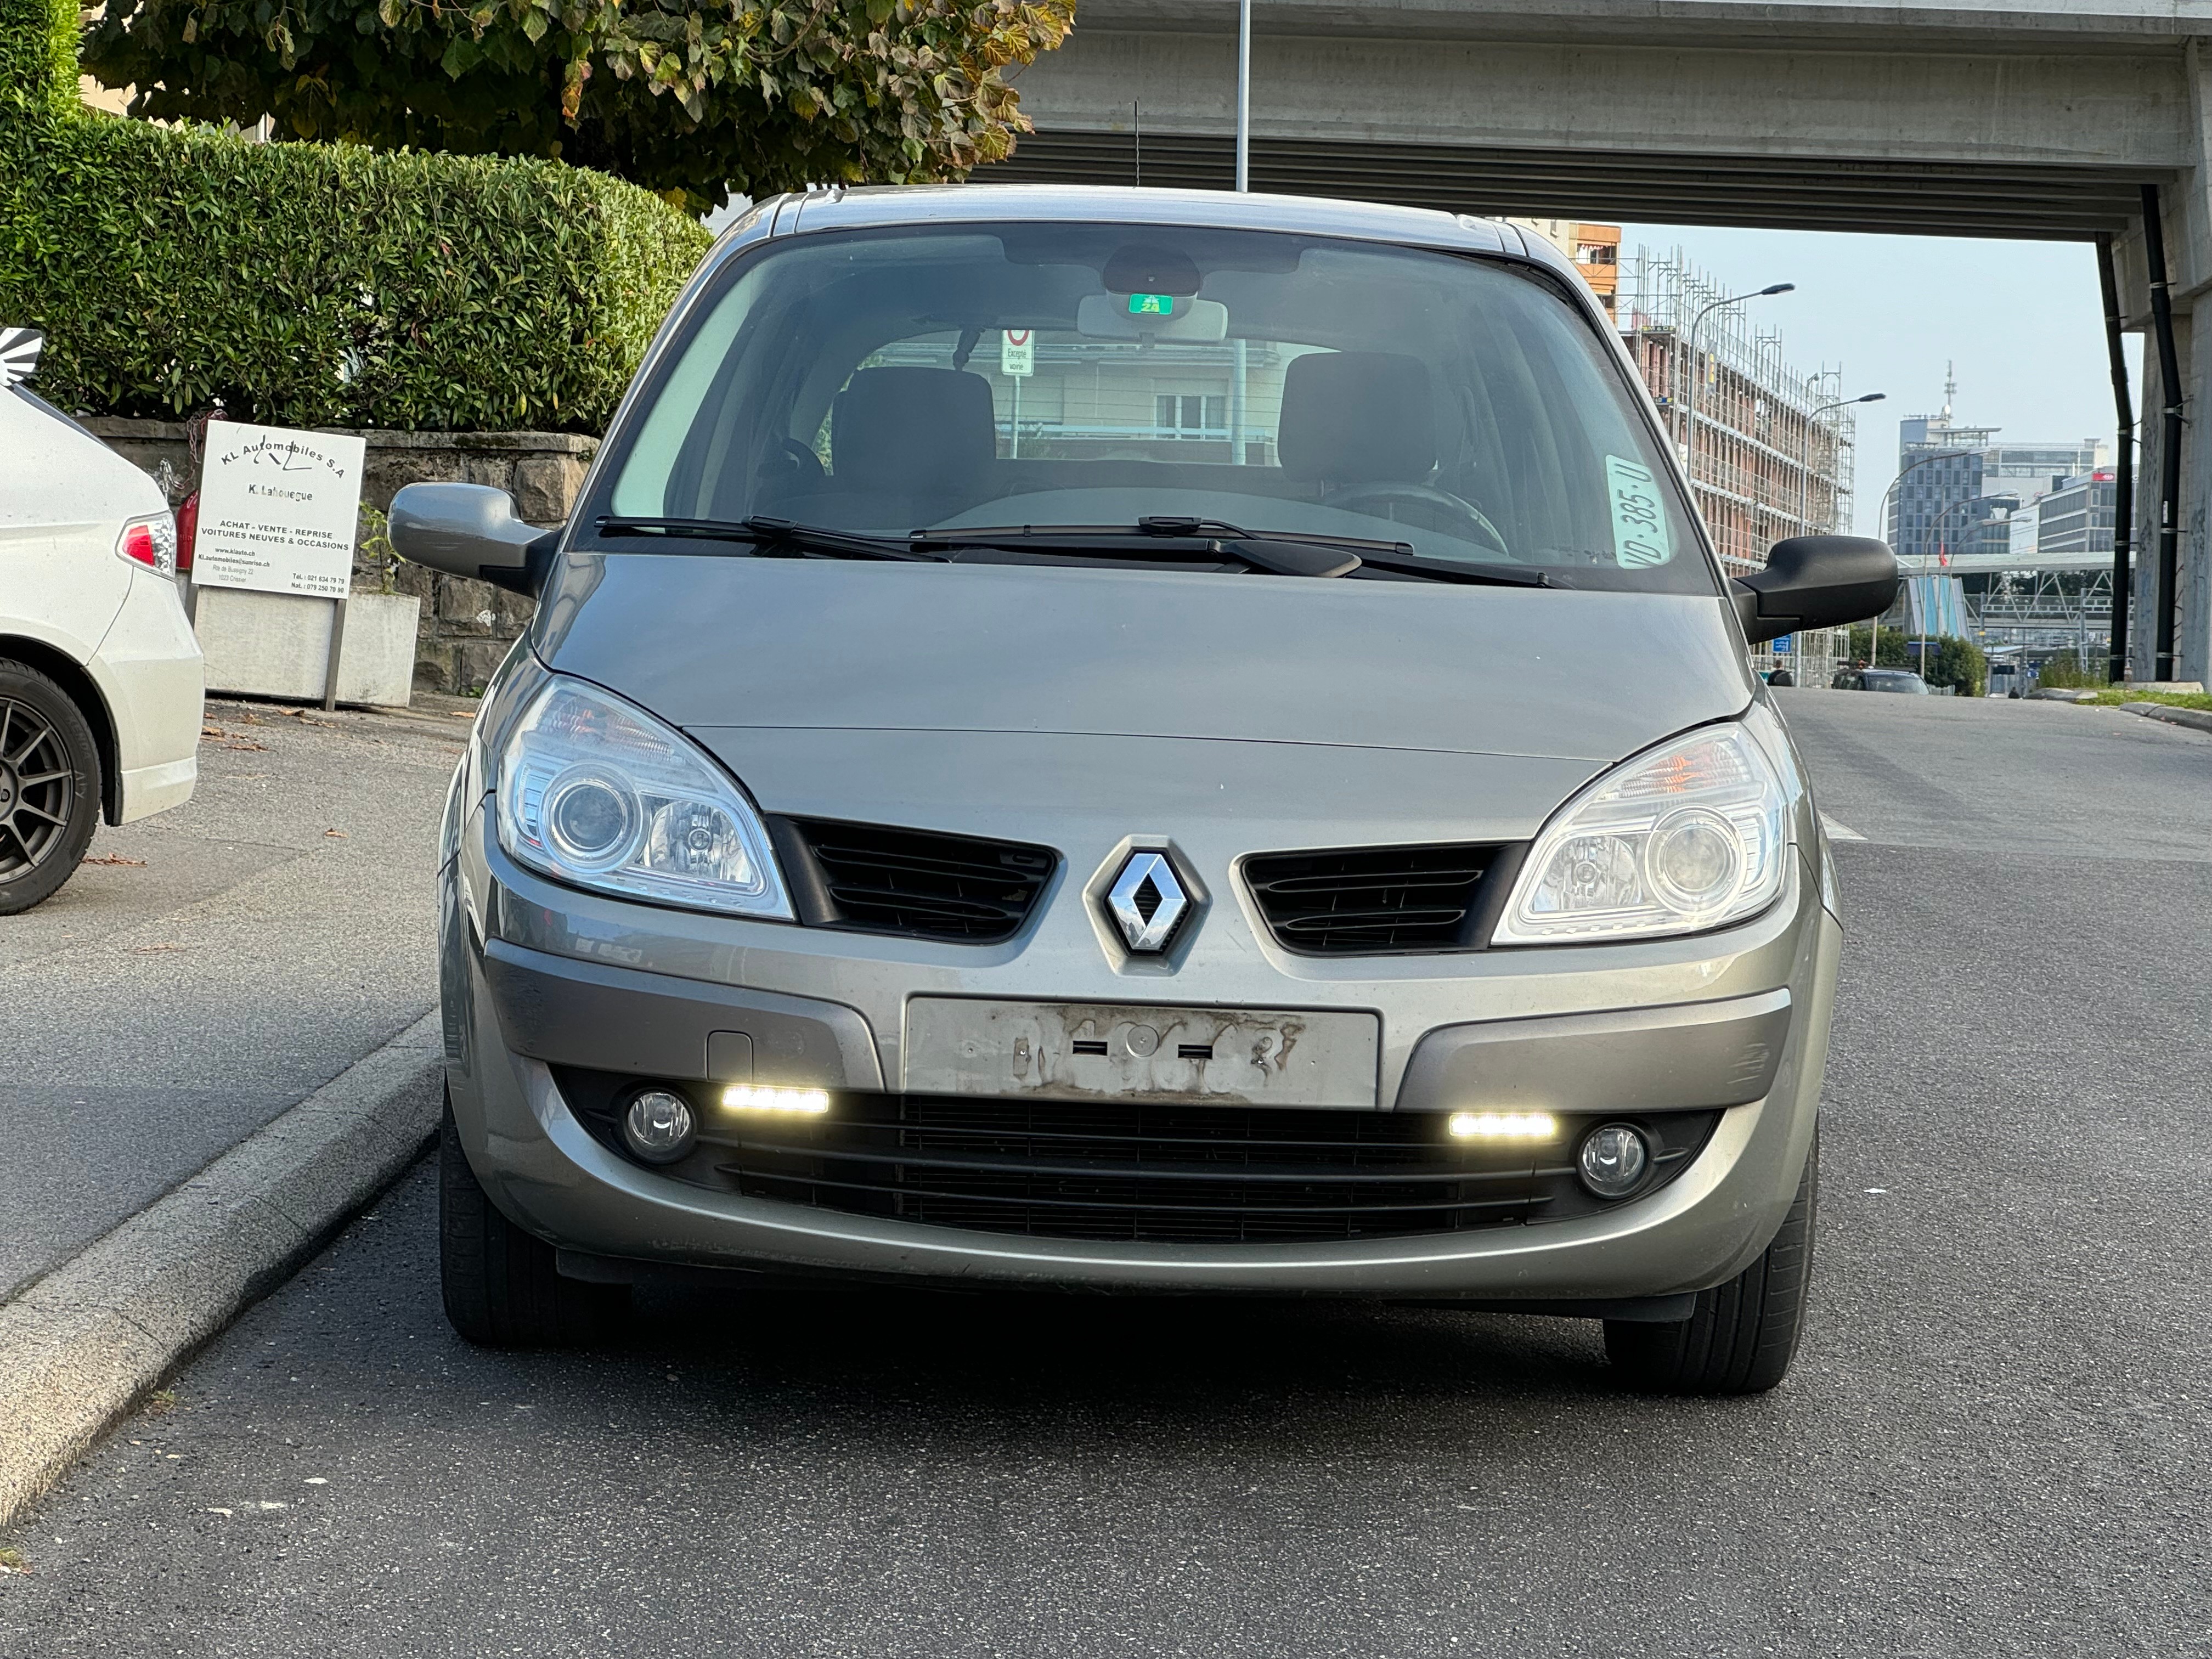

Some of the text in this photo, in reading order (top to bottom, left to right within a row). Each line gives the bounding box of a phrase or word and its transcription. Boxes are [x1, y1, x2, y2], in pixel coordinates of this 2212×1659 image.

[1141, 303, 1160, 312] 24
[1008, 348, 1026, 359] Excepté
[221, 442, 345, 478] KL Automobiles S.A
[219, 520, 250, 529] ACHAT
[258, 524, 287, 533] VENTE
[295, 529, 332, 539] REPRISE
[201, 528, 246, 539] VOITURES
[249, 533, 285, 543] NEUVES
[297, 539, 349, 550] OCCASIONS
[215, 548, 255, 556] www.klauto.ch
